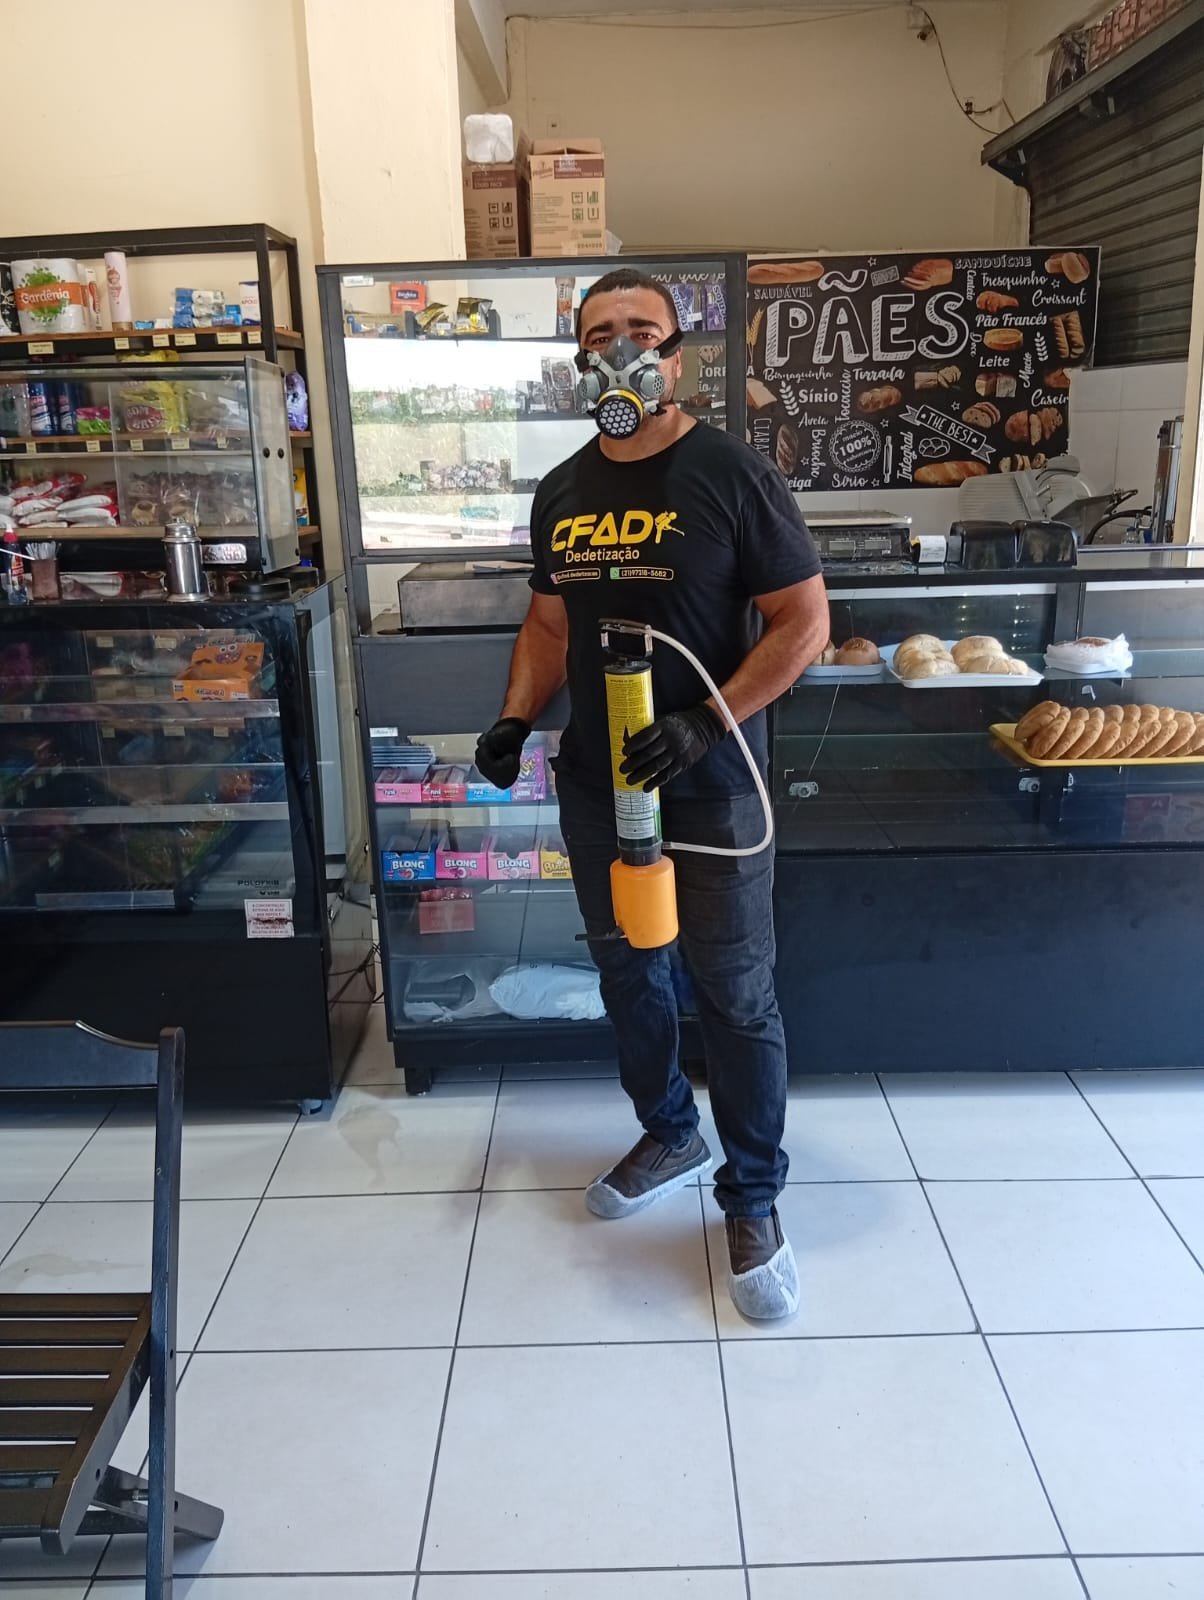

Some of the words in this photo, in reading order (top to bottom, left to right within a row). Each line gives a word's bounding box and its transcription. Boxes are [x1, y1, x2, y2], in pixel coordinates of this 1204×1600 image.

[955, 254, 1032, 270] SANDUÍCHE
[21, 288, 71, 305] Gardênia
[753, 284, 813, 300] SAUDÁVEL
[1032, 287, 1088, 307] Croissant
[765, 268, 969, 368] PÃES
[975, 312, 999, 328] Pão
[1001, 312, 1048, 327] Francês
[979, 355, 1010, 368] Leite
[798, 387, 838, 404] Sírio
[926, 411, 944, 432] THE
[946, 424, 974, 444] BEST
[839, 435, 872, 457] 100%
[896, 431, 918, 482] Integral
[785, 476, 813, 491] eiga
[565, 546, 640, 563] Dedetização
[392, 860, 425, 869] BLONG
[444, 859, 477, 869] BLONG
[497, 859, 530, 869] BLONG
